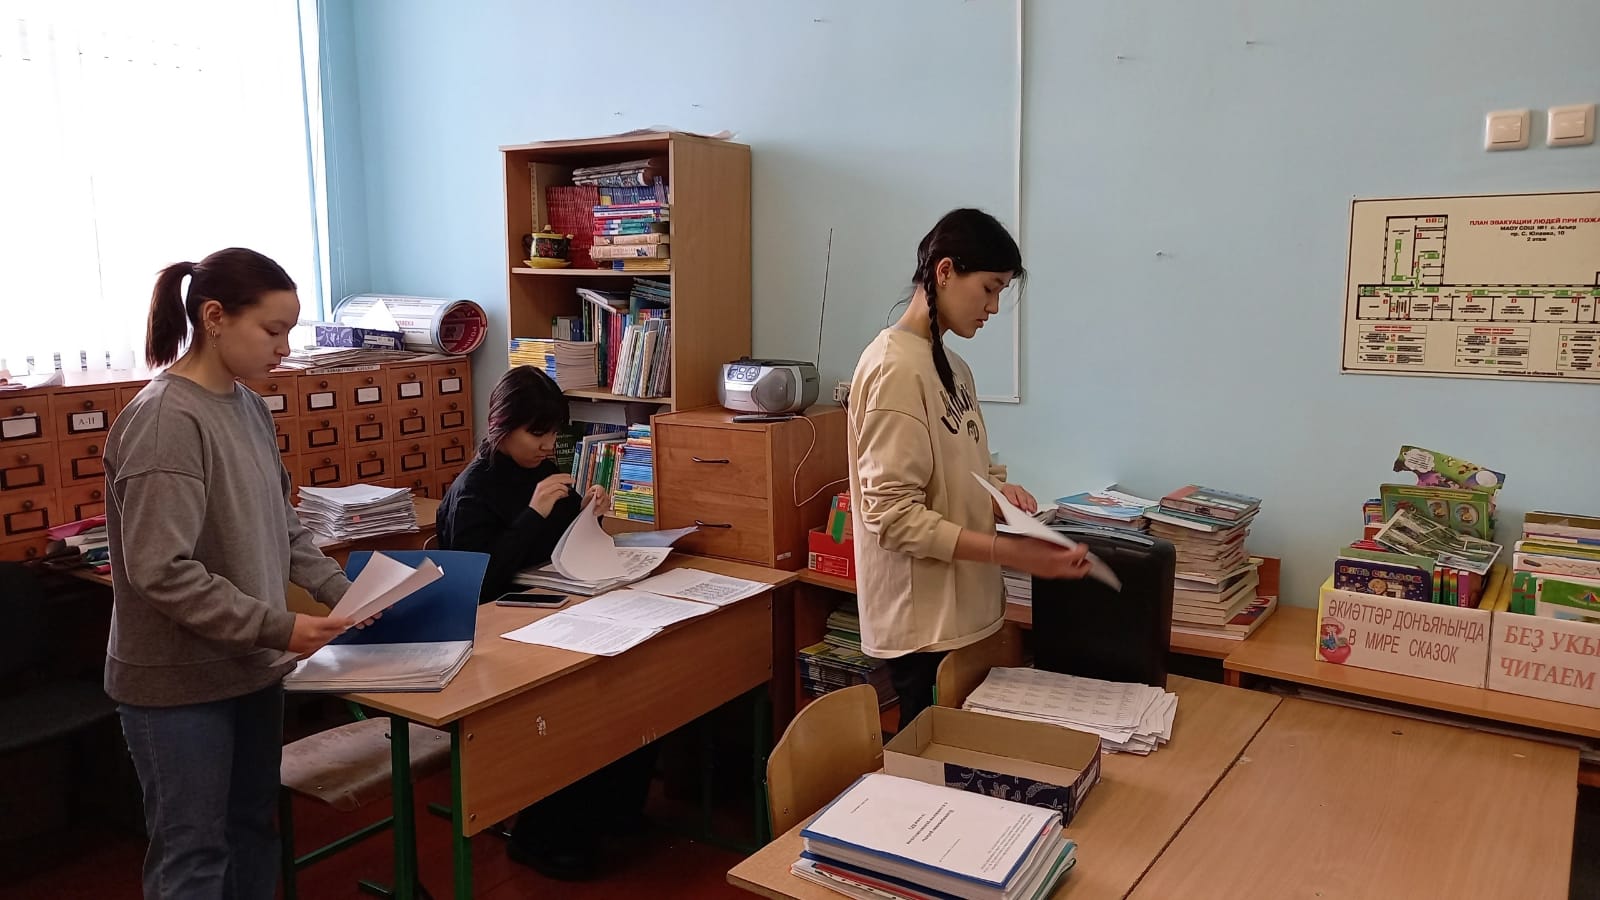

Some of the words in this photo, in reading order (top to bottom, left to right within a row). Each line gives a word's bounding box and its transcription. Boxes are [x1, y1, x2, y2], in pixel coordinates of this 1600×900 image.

[1533, 217, 1560, 225] ЛЮДЕЙ
[1348, 629, 1357, 646] В
[1364, 632, 1400, 654] МИРЕ
[1408, 639, 1459, 664] СКАЗОК
[1501, 657, 1596, 689] ЧИТАЕМ
